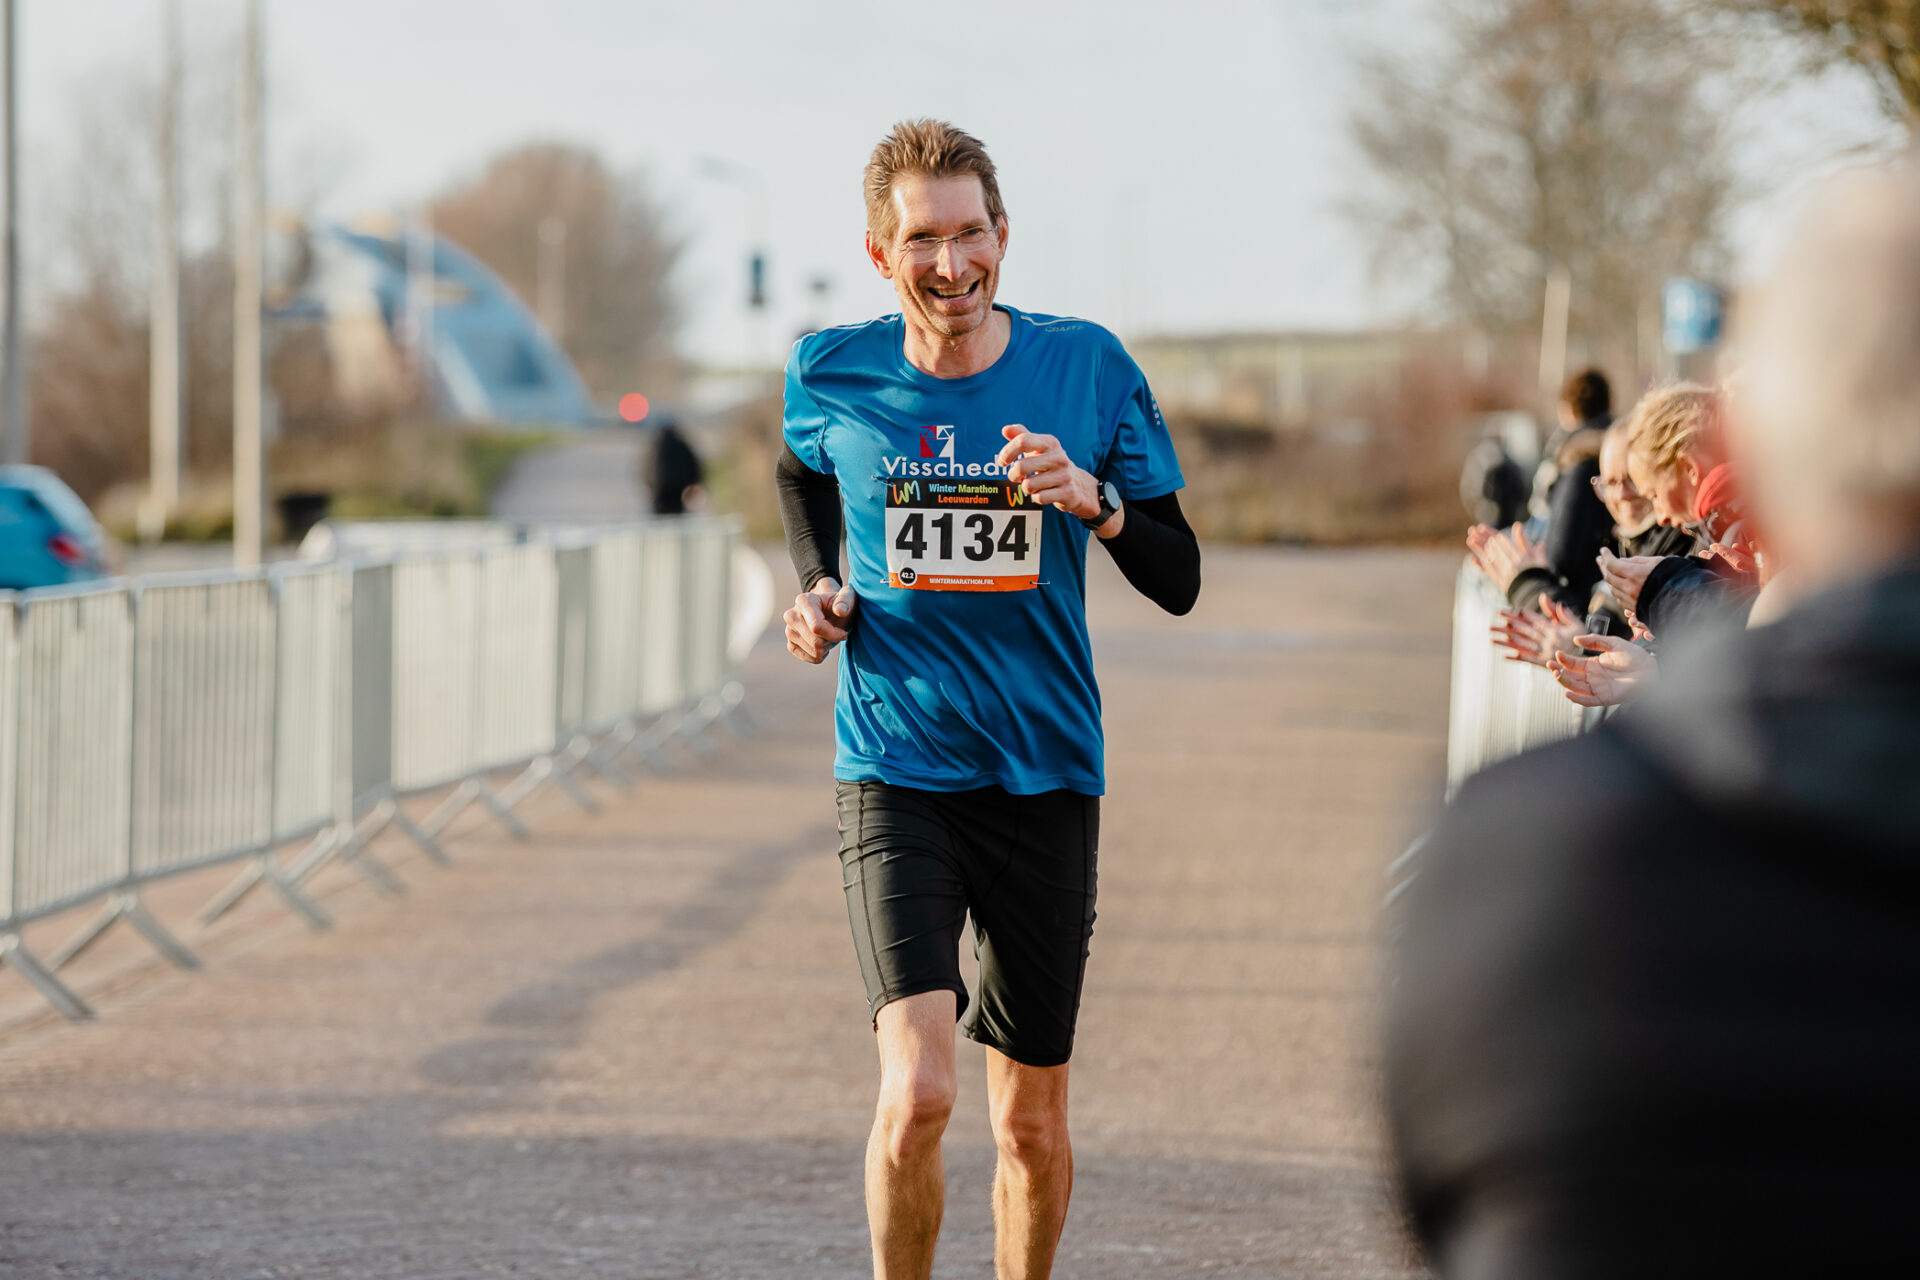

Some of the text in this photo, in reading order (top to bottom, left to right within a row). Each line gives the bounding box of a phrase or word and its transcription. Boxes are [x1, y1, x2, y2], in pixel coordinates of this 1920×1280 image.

[882, 453, 1038, 477] Visschedi
[928, 483, 999, 494] Winter Marathon
[938, 494, 989, 504] Leeuwarden
[895, 512, 1030, 561] 4134
[900, 571, 914, 579] 42.2
[929, 577, 995, 585] WINTERMARATHON.FRL
